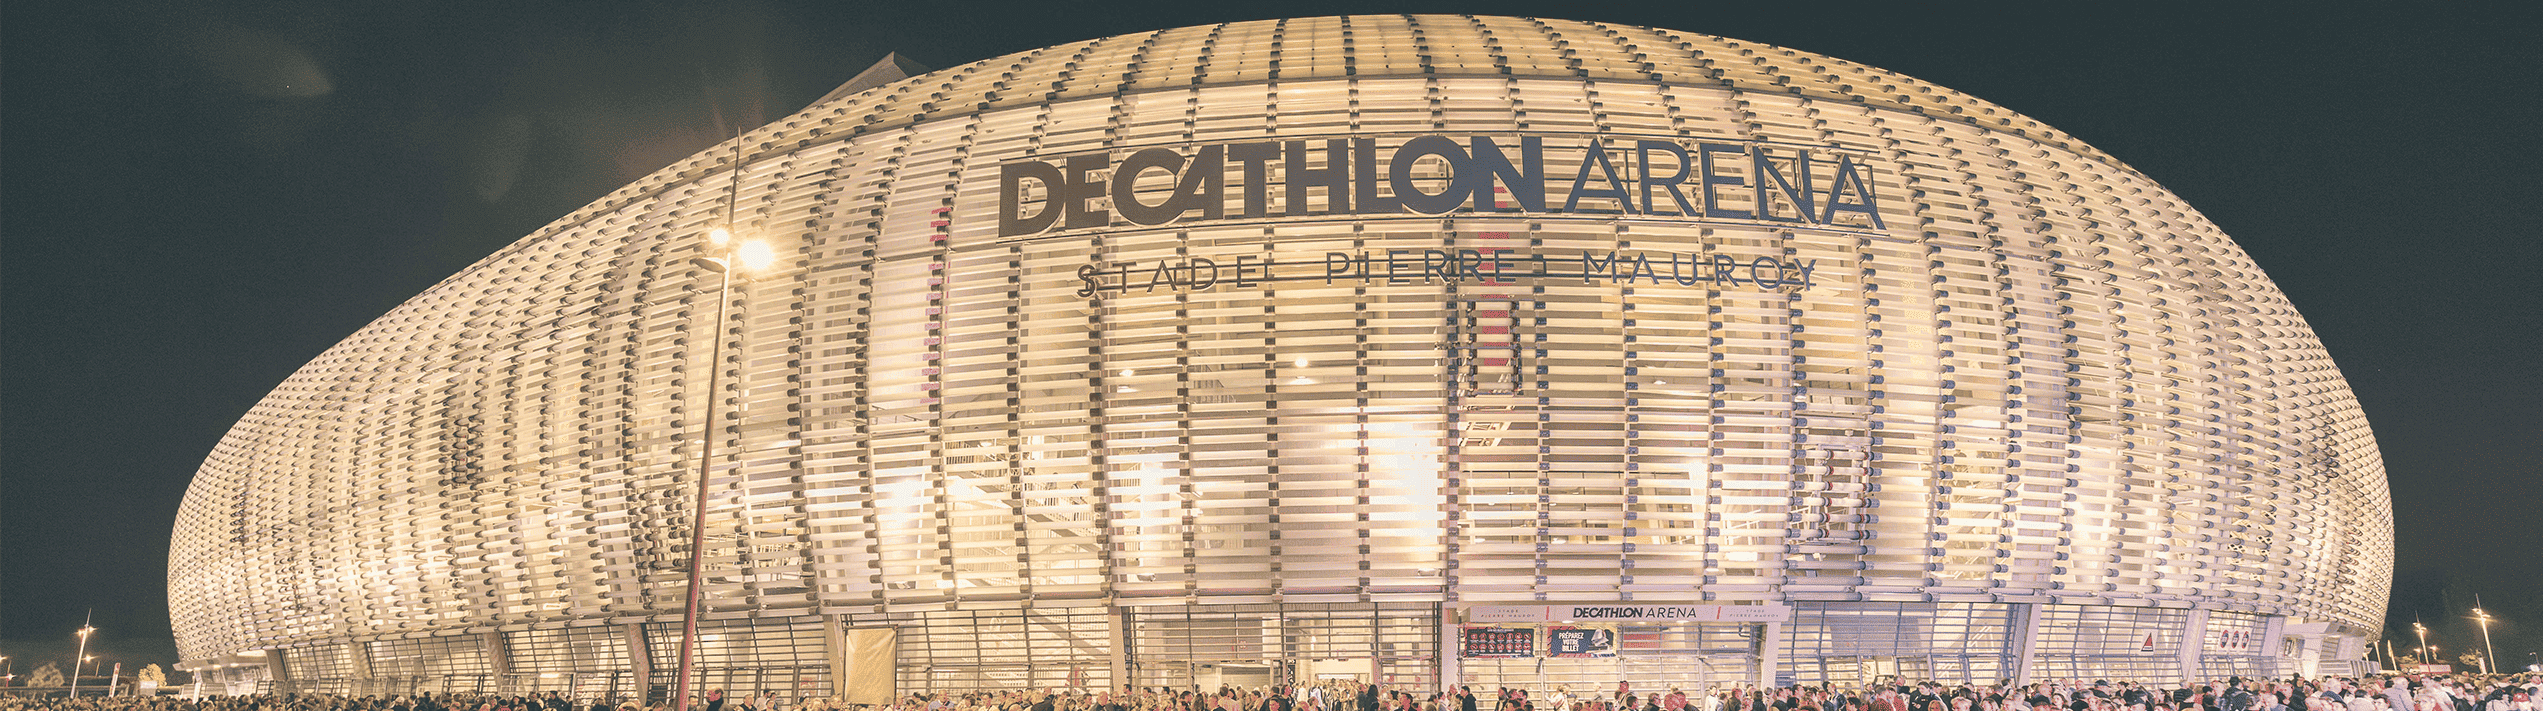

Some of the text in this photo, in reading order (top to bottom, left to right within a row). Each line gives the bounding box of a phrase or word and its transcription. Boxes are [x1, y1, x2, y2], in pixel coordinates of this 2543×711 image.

[998, 136, 1887, 238] DECATHLON ARENA
[1076, 249, 1817, 298] STADE PIERRE MAUROY
[1573, 607, 1697, 618] DECATHLON ARENA
[1558, 631, 1584, 640] PRÉPAREZ
